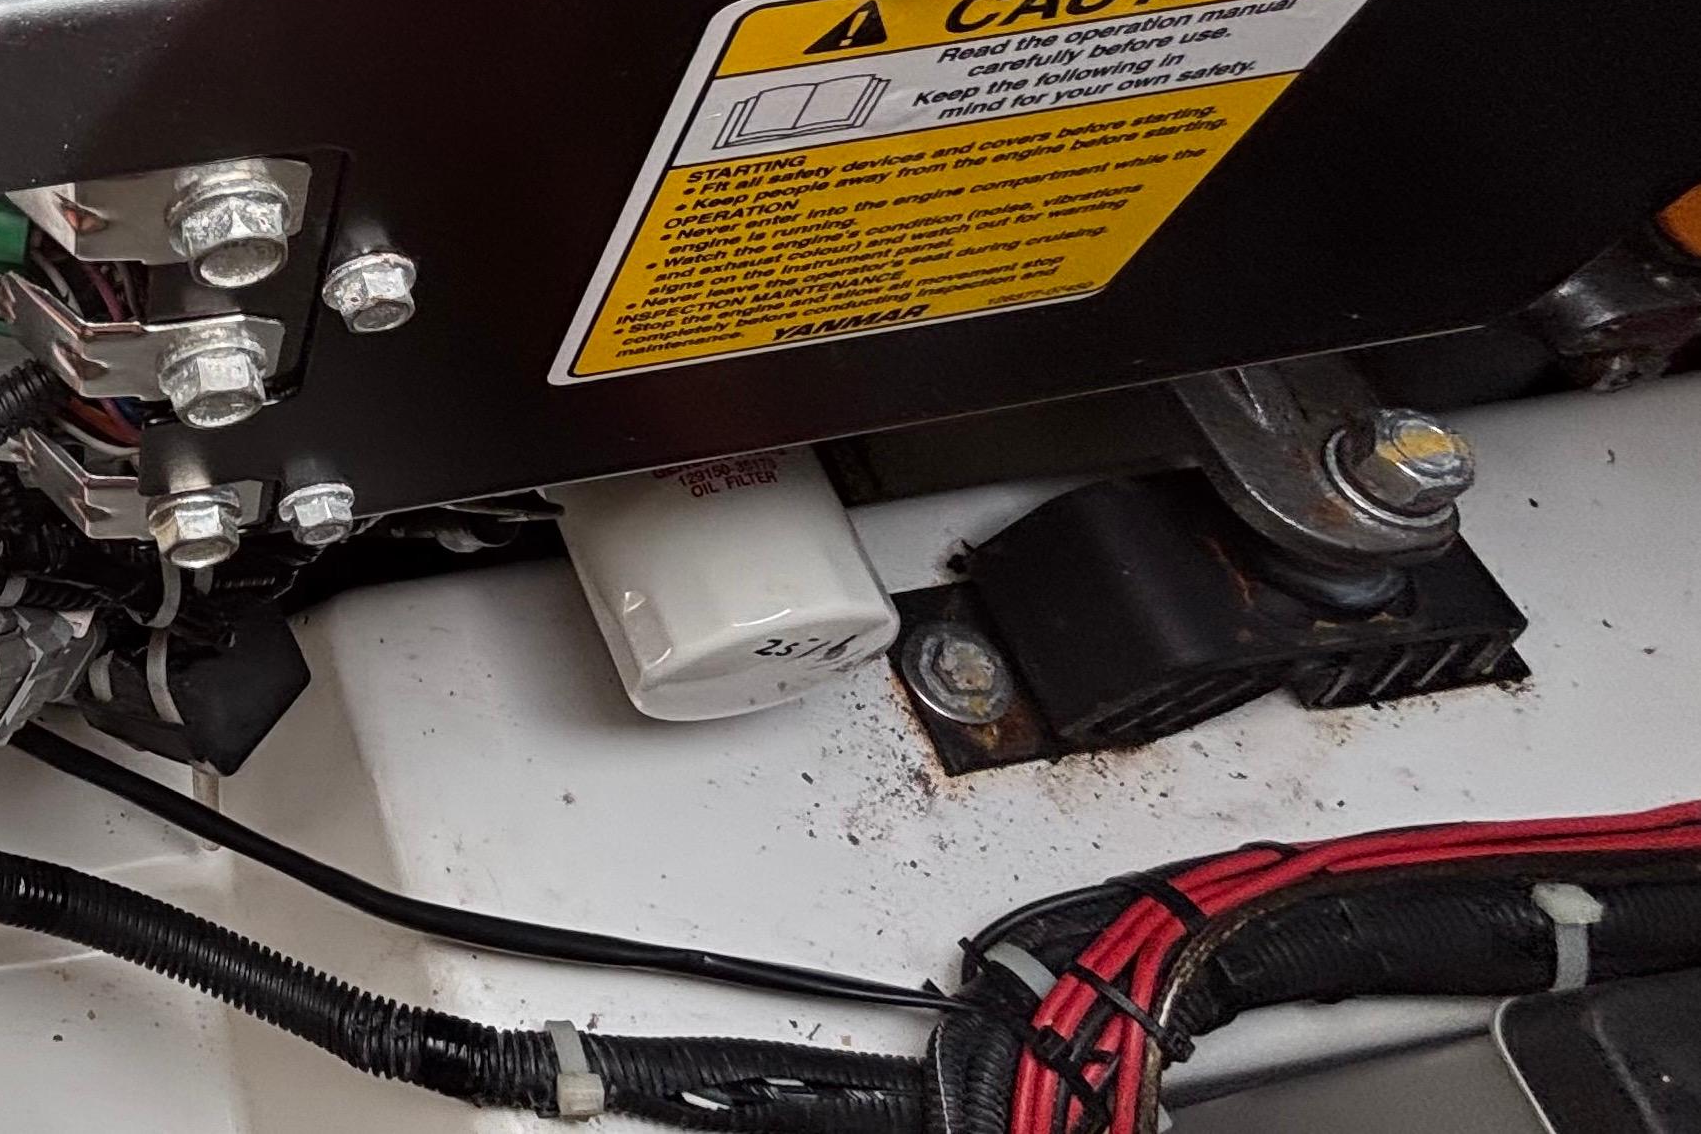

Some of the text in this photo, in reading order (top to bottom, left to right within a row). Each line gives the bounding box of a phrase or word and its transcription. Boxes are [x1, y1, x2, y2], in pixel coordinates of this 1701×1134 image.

[937, 39, 1012, 64] Read
[1014, 35, 1059, 51] the
[1064, 14, 1193, 45] operation
[967, 48, 1085, 77] carefully
[1087, 35, 1174, 59] before
[912, 53, 1185, 107] Keep the following in
[937, 97, 1008, 120] mind
[1010, 93, 1049, 108] for
[1049, 83, 1113, 105] your
[1117, 74, 1171, 91] own
[686, 155, 807, 183] STARTING
[692, 194, 749, 210] Keep
[753, 181, 830, 203] people
[834, 172, 892, 188] away
[896, 163, 947, 178] from
[953, 156, 987, 169] the
[992, 144, 1066, 163] engine
[1070, 132, 1139, 151] before
[735, 176, 764, 190] all
[767, 166, 837, 184] safety
[841, 152, 926, 172] devices
[931, 142, 976, 159] and
[978, 132, 1052, 151] covers
[1056, 120, 1127, 139] before
[664, 199, 800, 229] OPERATION
[676, 223, 741, 240] Never
[745, 213, 802, 229] enter
[854, 200, 888, 212] the
[892, 187, 965, 206] engine
[970, 162, 1110, 193] compartment
[1114, 154, 1169, 170] while
[1172, 149, 1206, 160] the
[654, 199, 1128, 282] and exhaust colour) and watch out for warning
[664, 250, 728, 268] Watch
[733, 245, 767, 257] the
[771, 230, 861, 251] engine's
[865, 214, 963, 236] condition
[1043, 184, 1144, 207] vibrations
[668, 236, 742, 254] engine
[747, 231, 766, 242] is
[616, 270, 905, 325] INSPECTION MAINTENANCE
[628, 256, 1064, 333] Stop the engine and allow all movement stop
[641, 292, 702, 308] Never
[706, 283, 760, 298] leave
[765, 278, 798, 289] the
[802, 259, 904, 283] operator's
[909, 250, 953, 265] seat
[956, 240, 1021, 257] during
[648, 280, 705, 295] signs
[710, 275, 737, 285] on
[742, 269, 775, 280] the
[622, 322, 730, 346] completely
[735, 311, 798, 327] before
[802, 292, 912, 316] conducting
[1020, 266, 1059, 280] and
[772, 304, 930, 341] YANMAR
[691, 470, 778, 498] OIL FILTER
